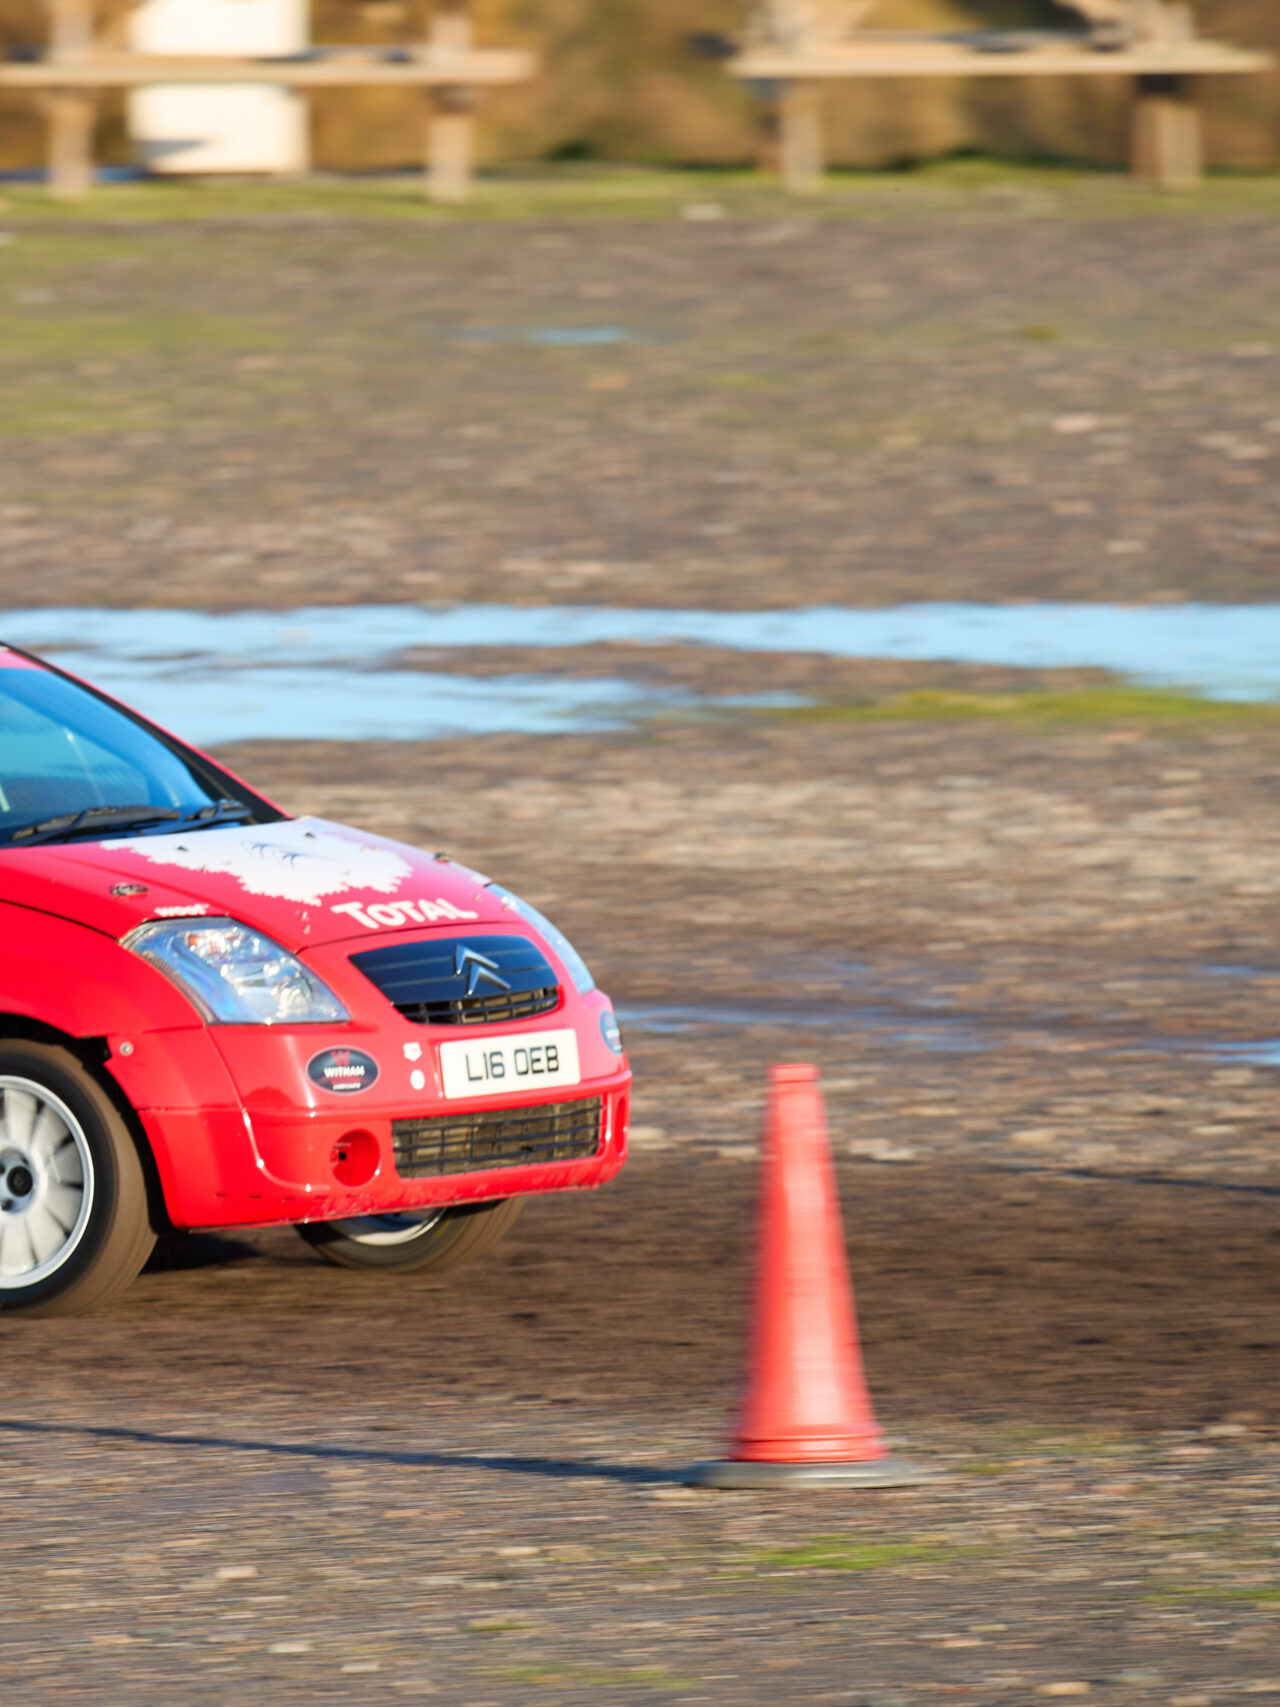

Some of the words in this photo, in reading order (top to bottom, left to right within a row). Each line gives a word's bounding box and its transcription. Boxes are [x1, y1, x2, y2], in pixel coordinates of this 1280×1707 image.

[330, 898, 479, 929] TOTAL
[465, 1051, 506, 1081] L16
[514, 1044, 560, 1076] OEB
